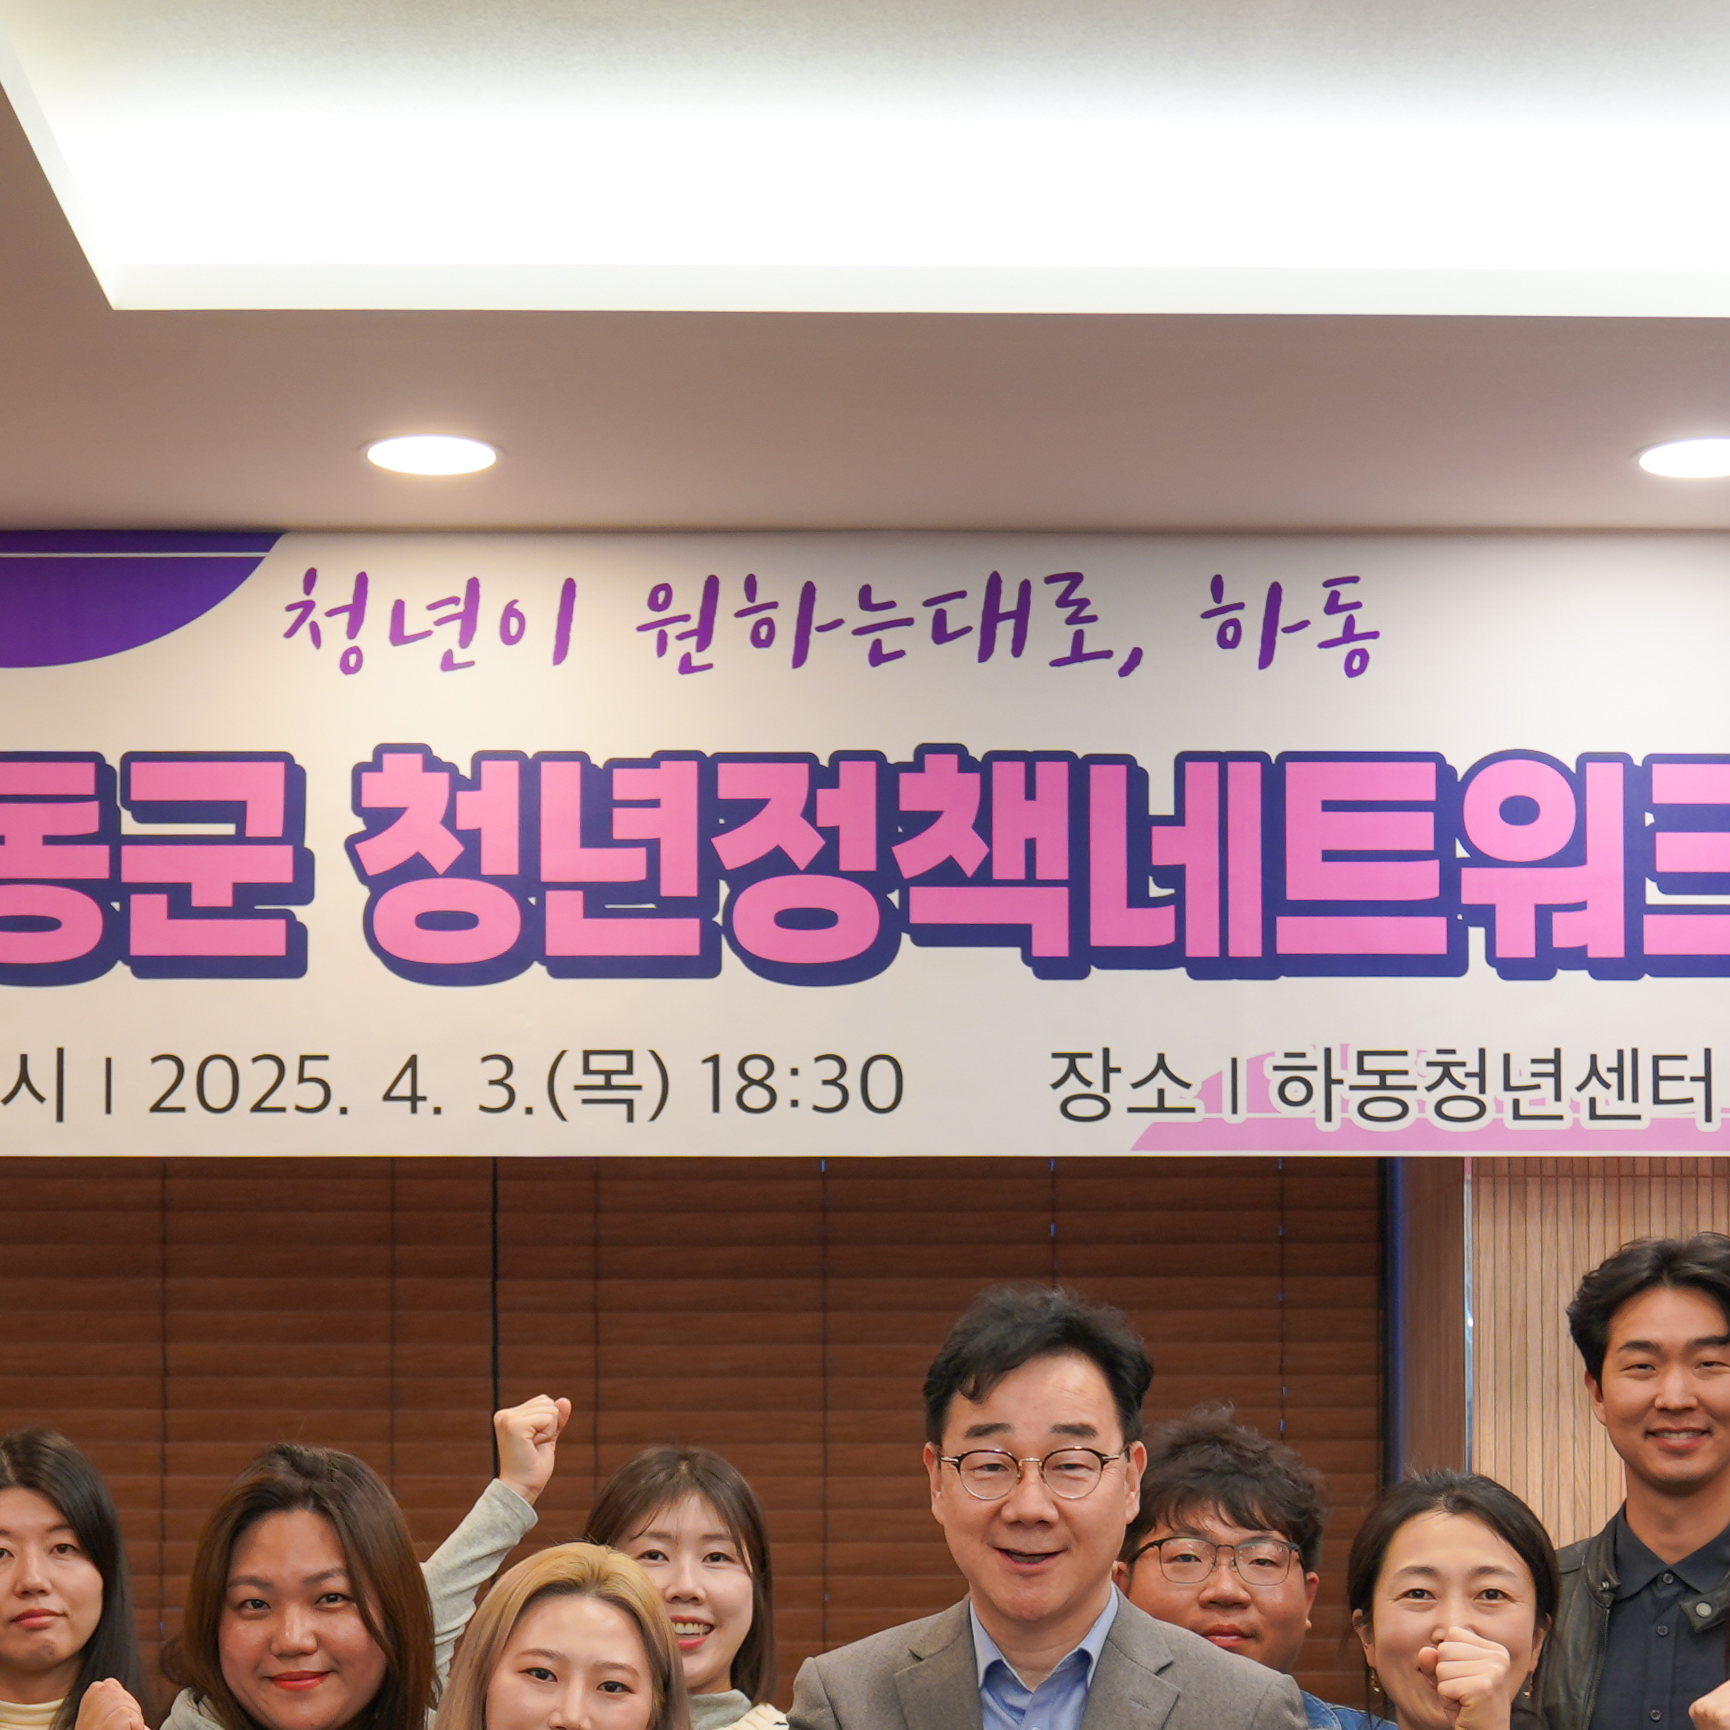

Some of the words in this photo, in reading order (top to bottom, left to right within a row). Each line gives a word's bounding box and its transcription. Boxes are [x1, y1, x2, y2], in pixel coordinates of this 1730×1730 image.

[283, 567, 576, 676] 청년이
[636, 571, 1143, 678] 원하는대로,
[1200, 574, 1380, 678] 하동
[149, 1054, 349, 1115] 2025.
[382, 1054, 443, 1115] 4.
[479, 1048, 670, 1124] 3.(목)
[702, 1053, 904, 1115] 18:30
[1050, 1047, 1197, 1124] 장소
[1272, 1047, 1717, 1124] 하동청년센터
